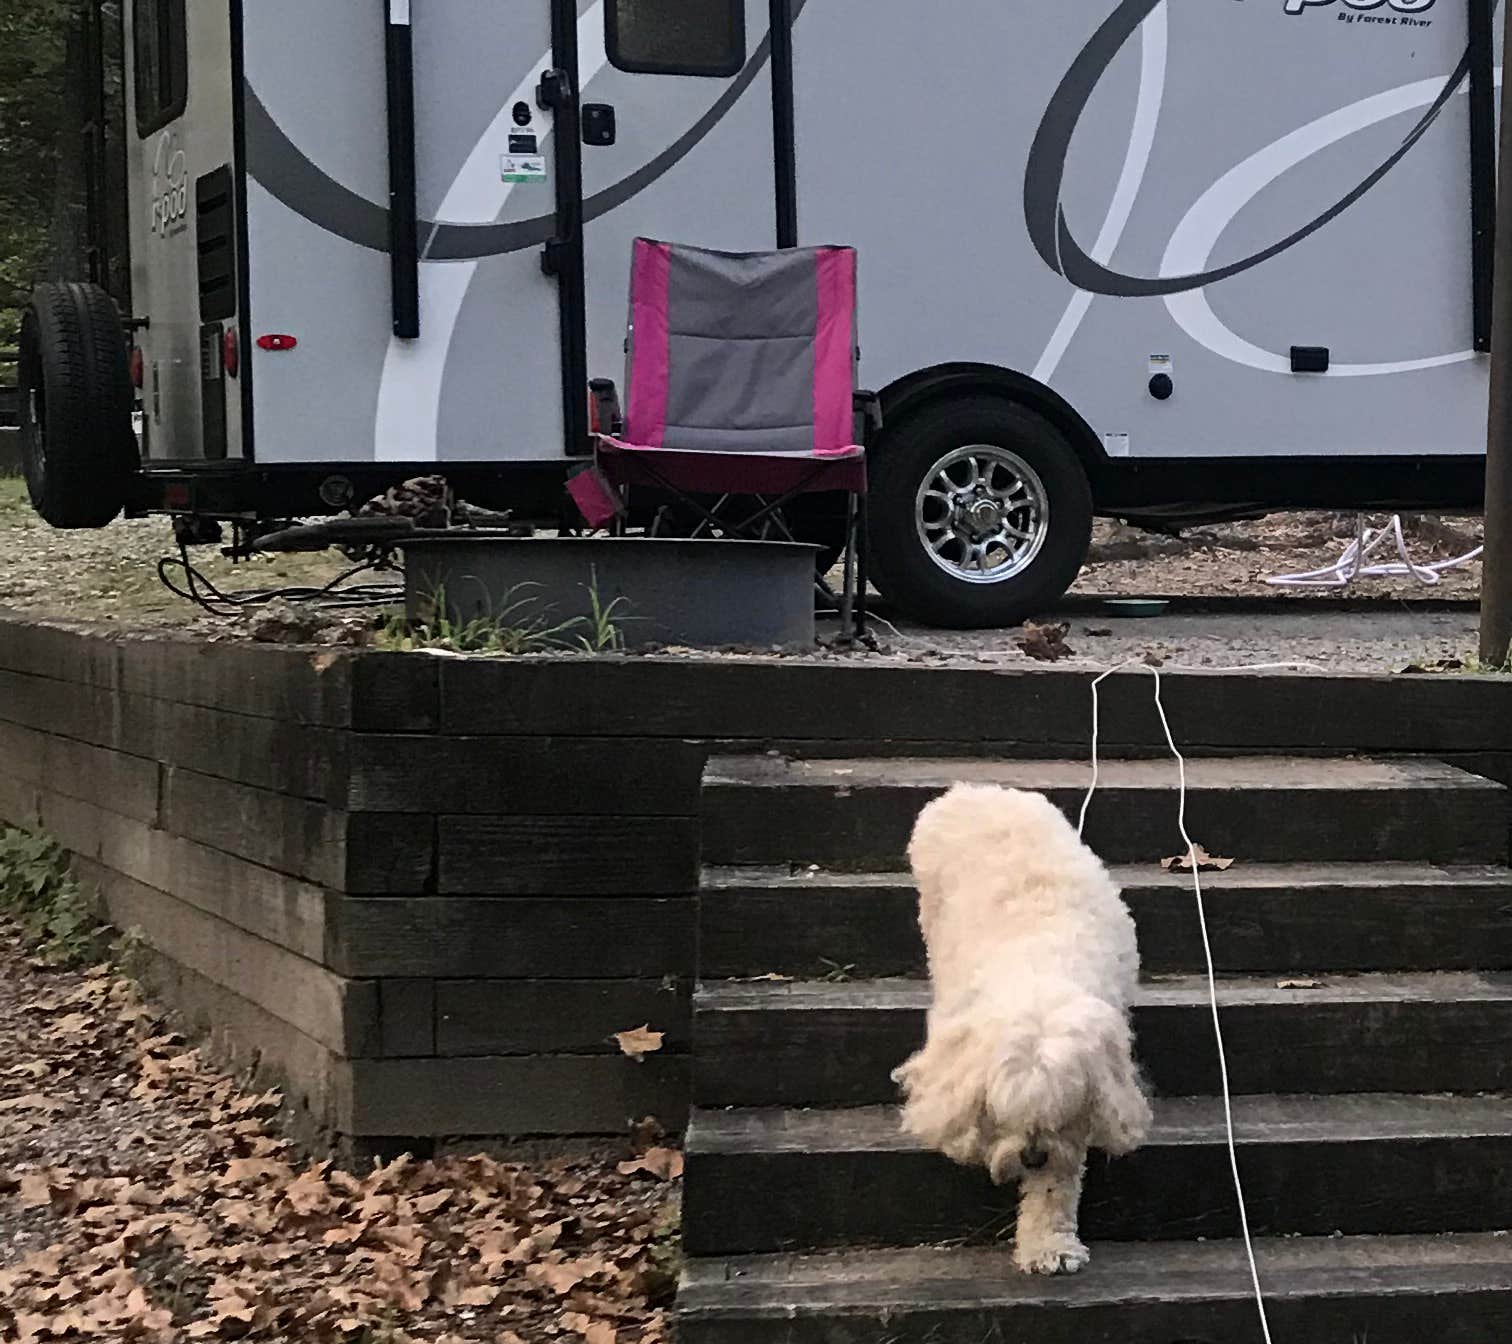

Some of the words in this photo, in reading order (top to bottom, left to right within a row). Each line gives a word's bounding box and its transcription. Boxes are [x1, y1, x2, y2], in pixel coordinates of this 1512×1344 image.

[1337, 12, 1354, 24] By
[1356, 14, 1398, 25] Forest
[1399, 17, 1433, 28] River
